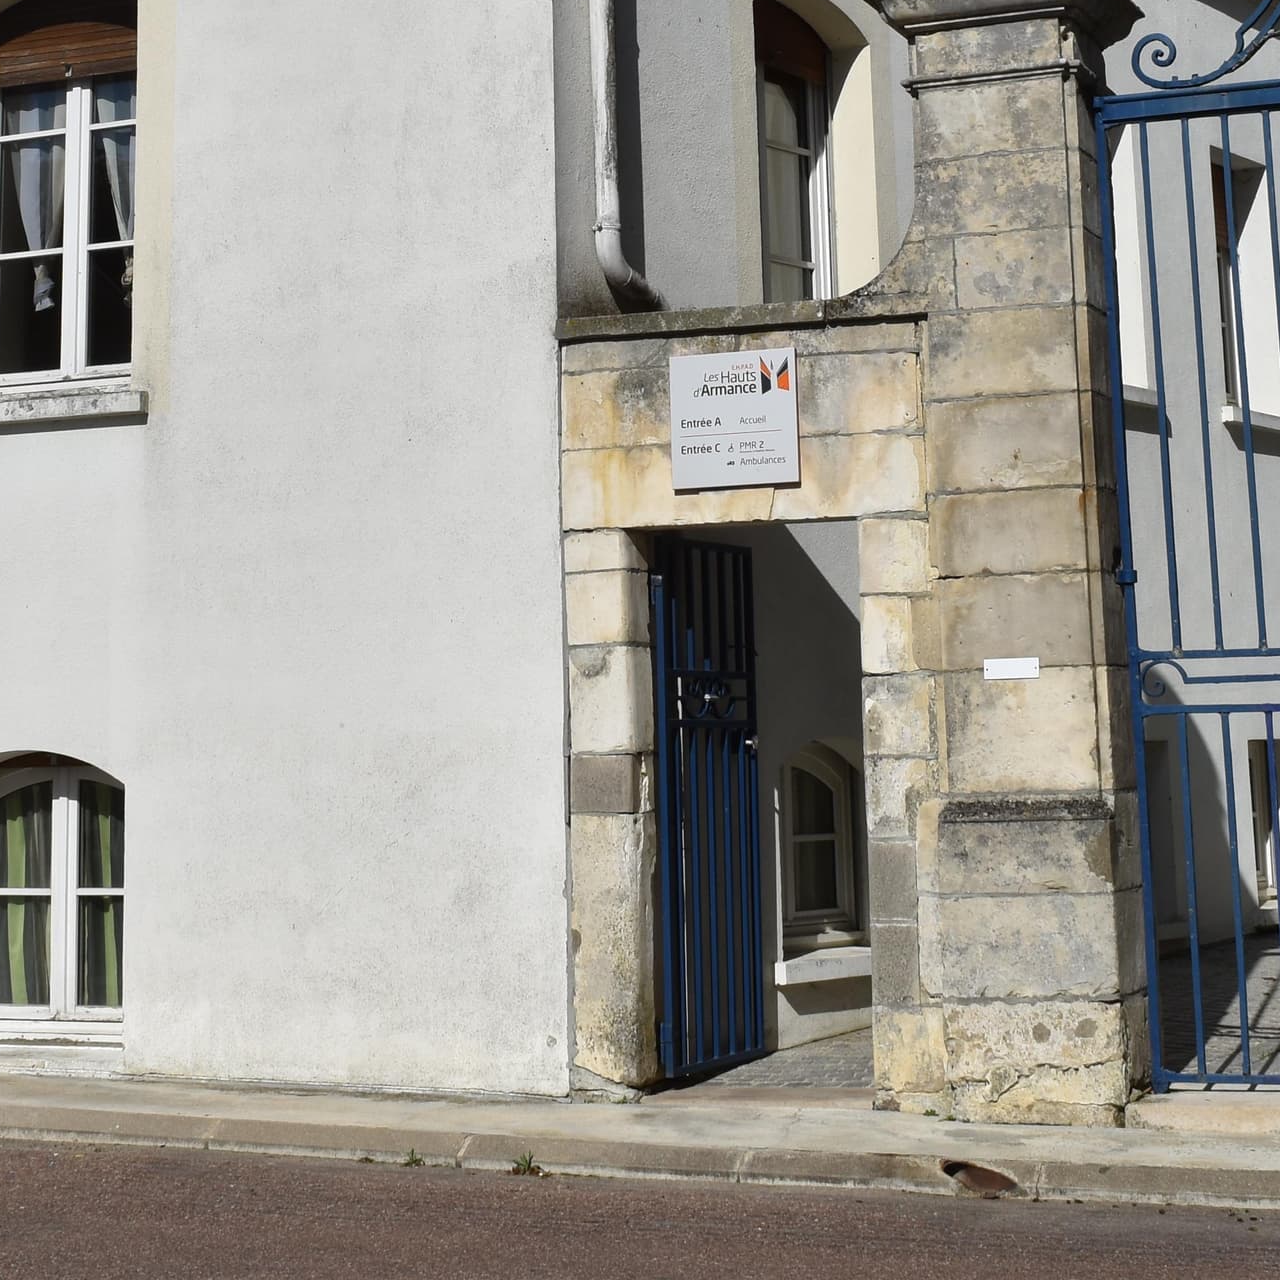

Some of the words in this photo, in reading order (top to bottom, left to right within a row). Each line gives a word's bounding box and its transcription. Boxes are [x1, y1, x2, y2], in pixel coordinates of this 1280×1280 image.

[703, 371, 719, 383] Les
[720, 370, 757, 384] Hauts
[693, 383, 757, 398] d'Armance
[680, 417, 712, 429] Entrée
[714, 416, 722, 427] A
[739, 415, 767, 425] Accueil
[680, 444, 713, 455] Entrée
[714, 442, 721, 453] C
[739, 441, 757, 450] PMR
[758, 440, 765, 449] 2
[739, 456, 787, 466] Ambulances
